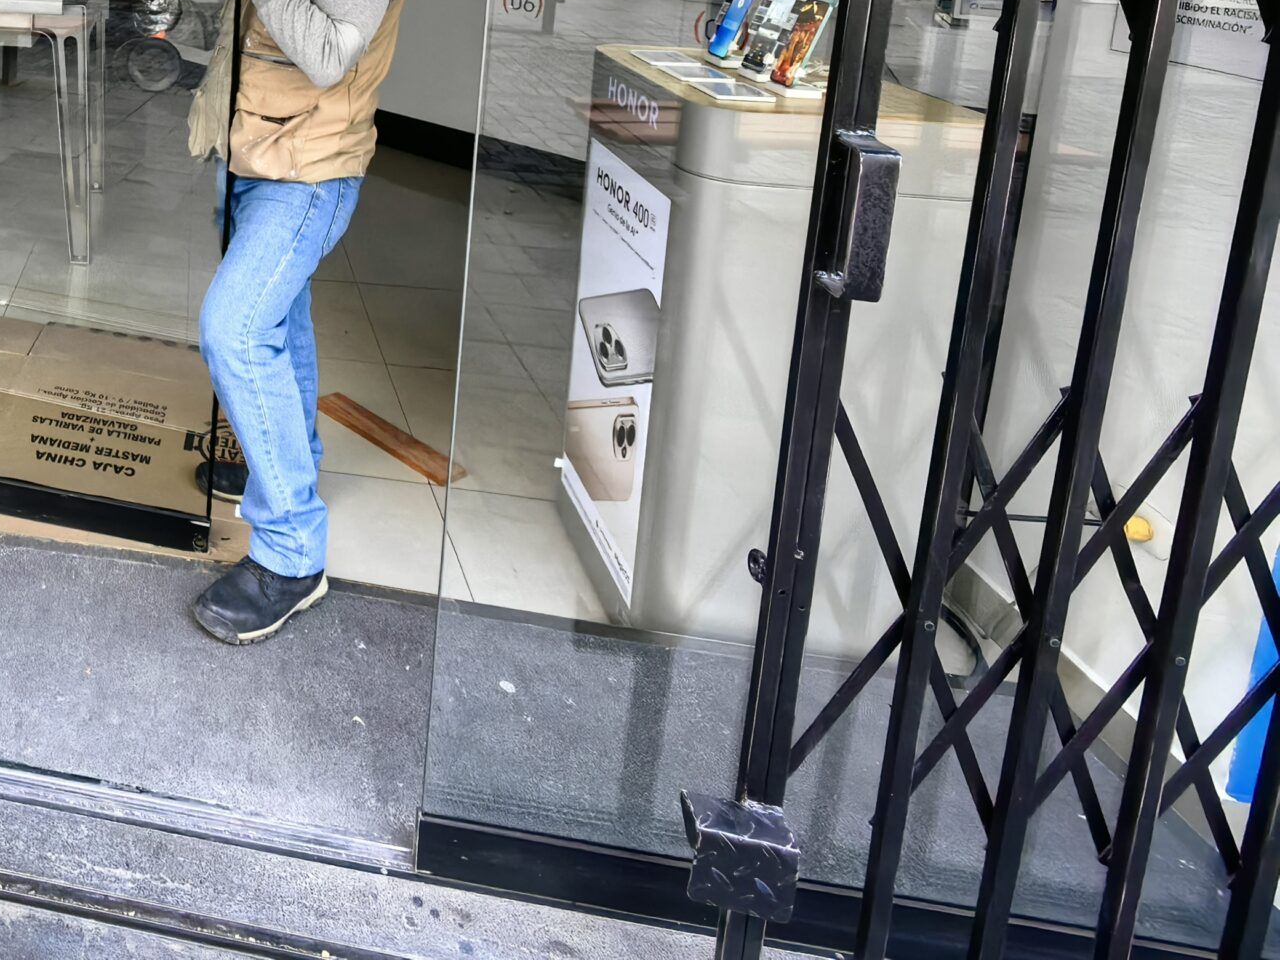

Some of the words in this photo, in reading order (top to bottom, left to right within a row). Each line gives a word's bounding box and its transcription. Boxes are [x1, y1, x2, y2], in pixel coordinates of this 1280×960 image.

[1210, 6, 1221, 15] EL
[608, 76, 659, 130] HONOR
[596, 167, 631, 212] HONOR
[632, 201, 650, 228] 400
[105, 401, 117, 409] de
[118, 403, 166, 418] Capacidad
[31, 415, 85, 432] VARILLAS
[61, 411, 138, 432] GALVANIZADA
[88, 426, 103, 435] DE
[106, 429, 162, 446] PARRILLA
[30, 433, 92, 454] MEDIANA
[35, 450, 87, 468] CHINA
[94, 445, 151, 465] MASTER
[92, 460, 136, 477] CAJA
